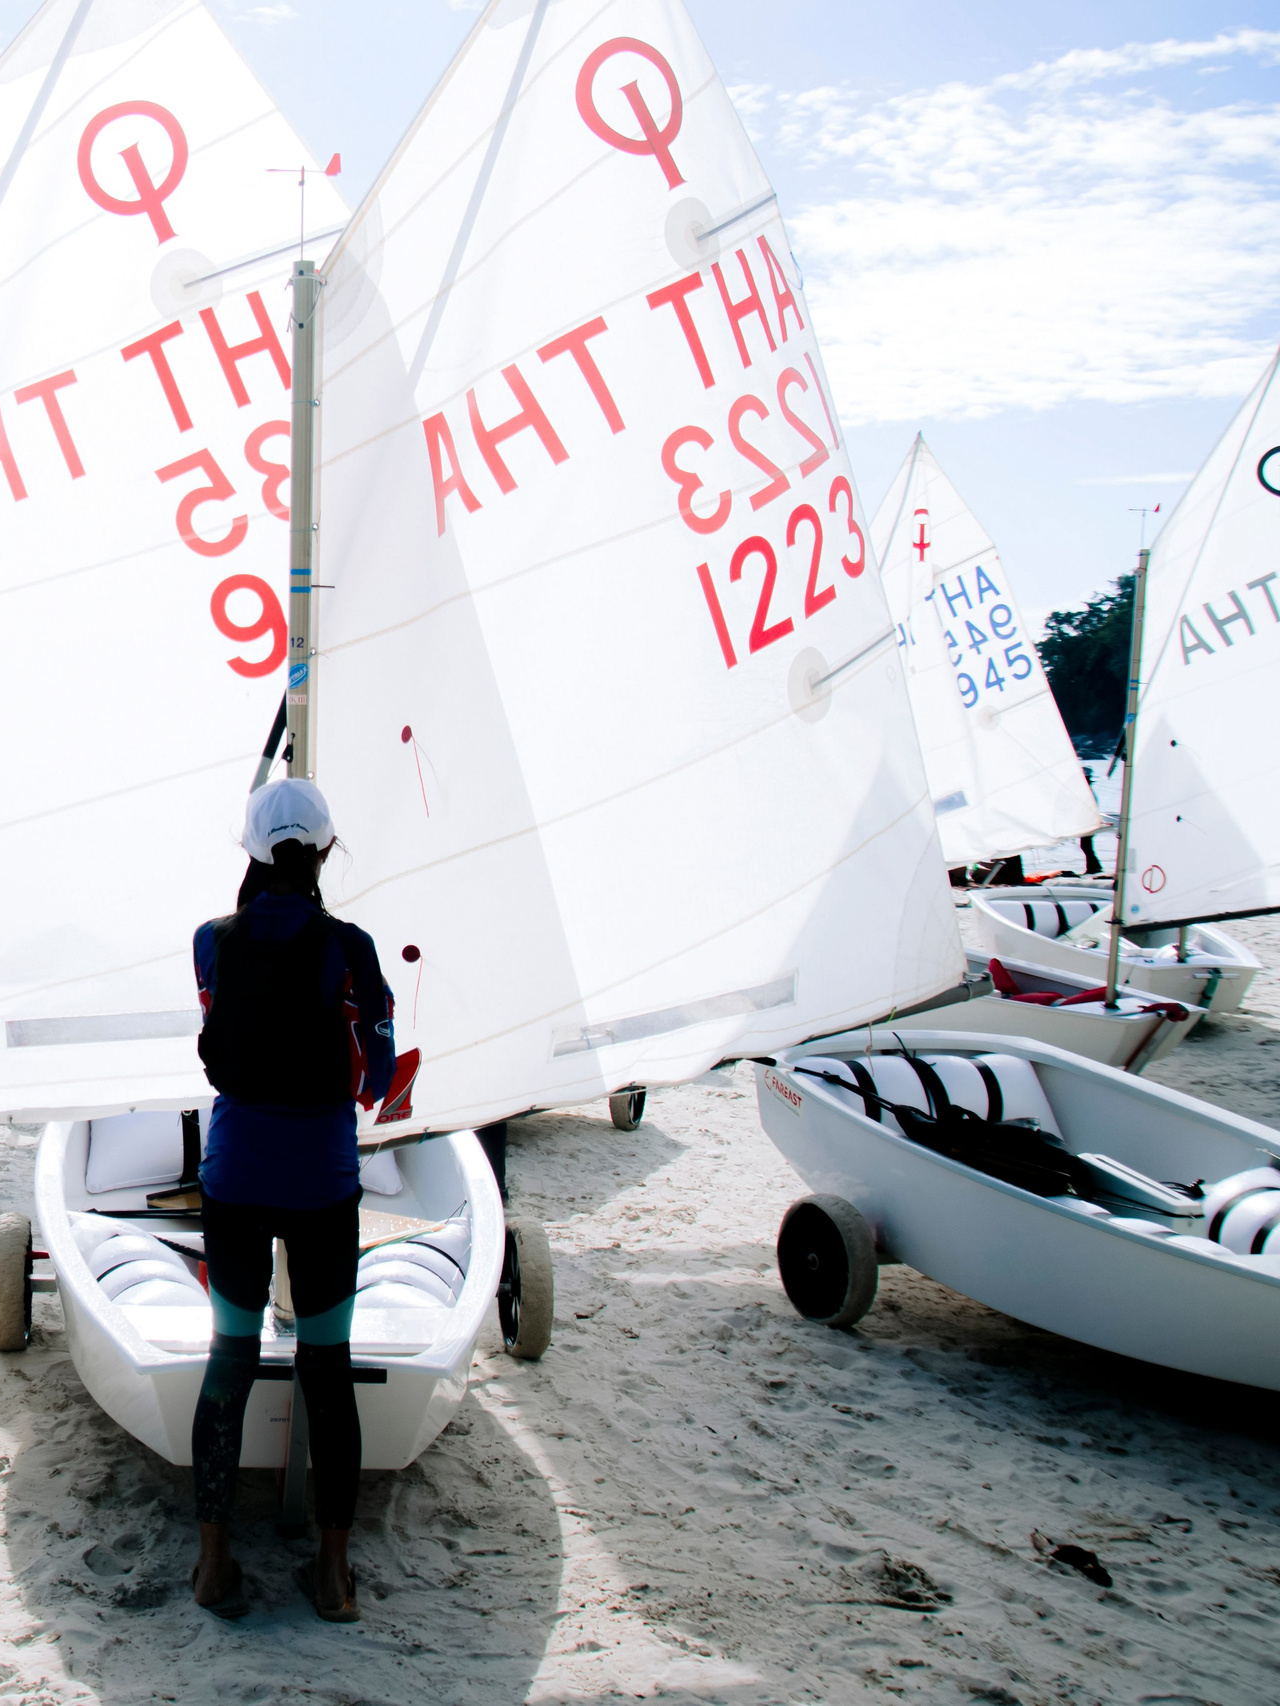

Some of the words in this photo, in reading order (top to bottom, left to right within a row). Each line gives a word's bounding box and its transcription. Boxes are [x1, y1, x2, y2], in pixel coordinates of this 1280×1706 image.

[645, 235, 805, 391] THA
[696, 475, 866, 670] 1223
[290, 637, 304, 649] 12
[957, 642, 1033, 709] 945
[772, 1076, 803, 1108] FAREAST
[377, 1111, 412, 1123] ONE
